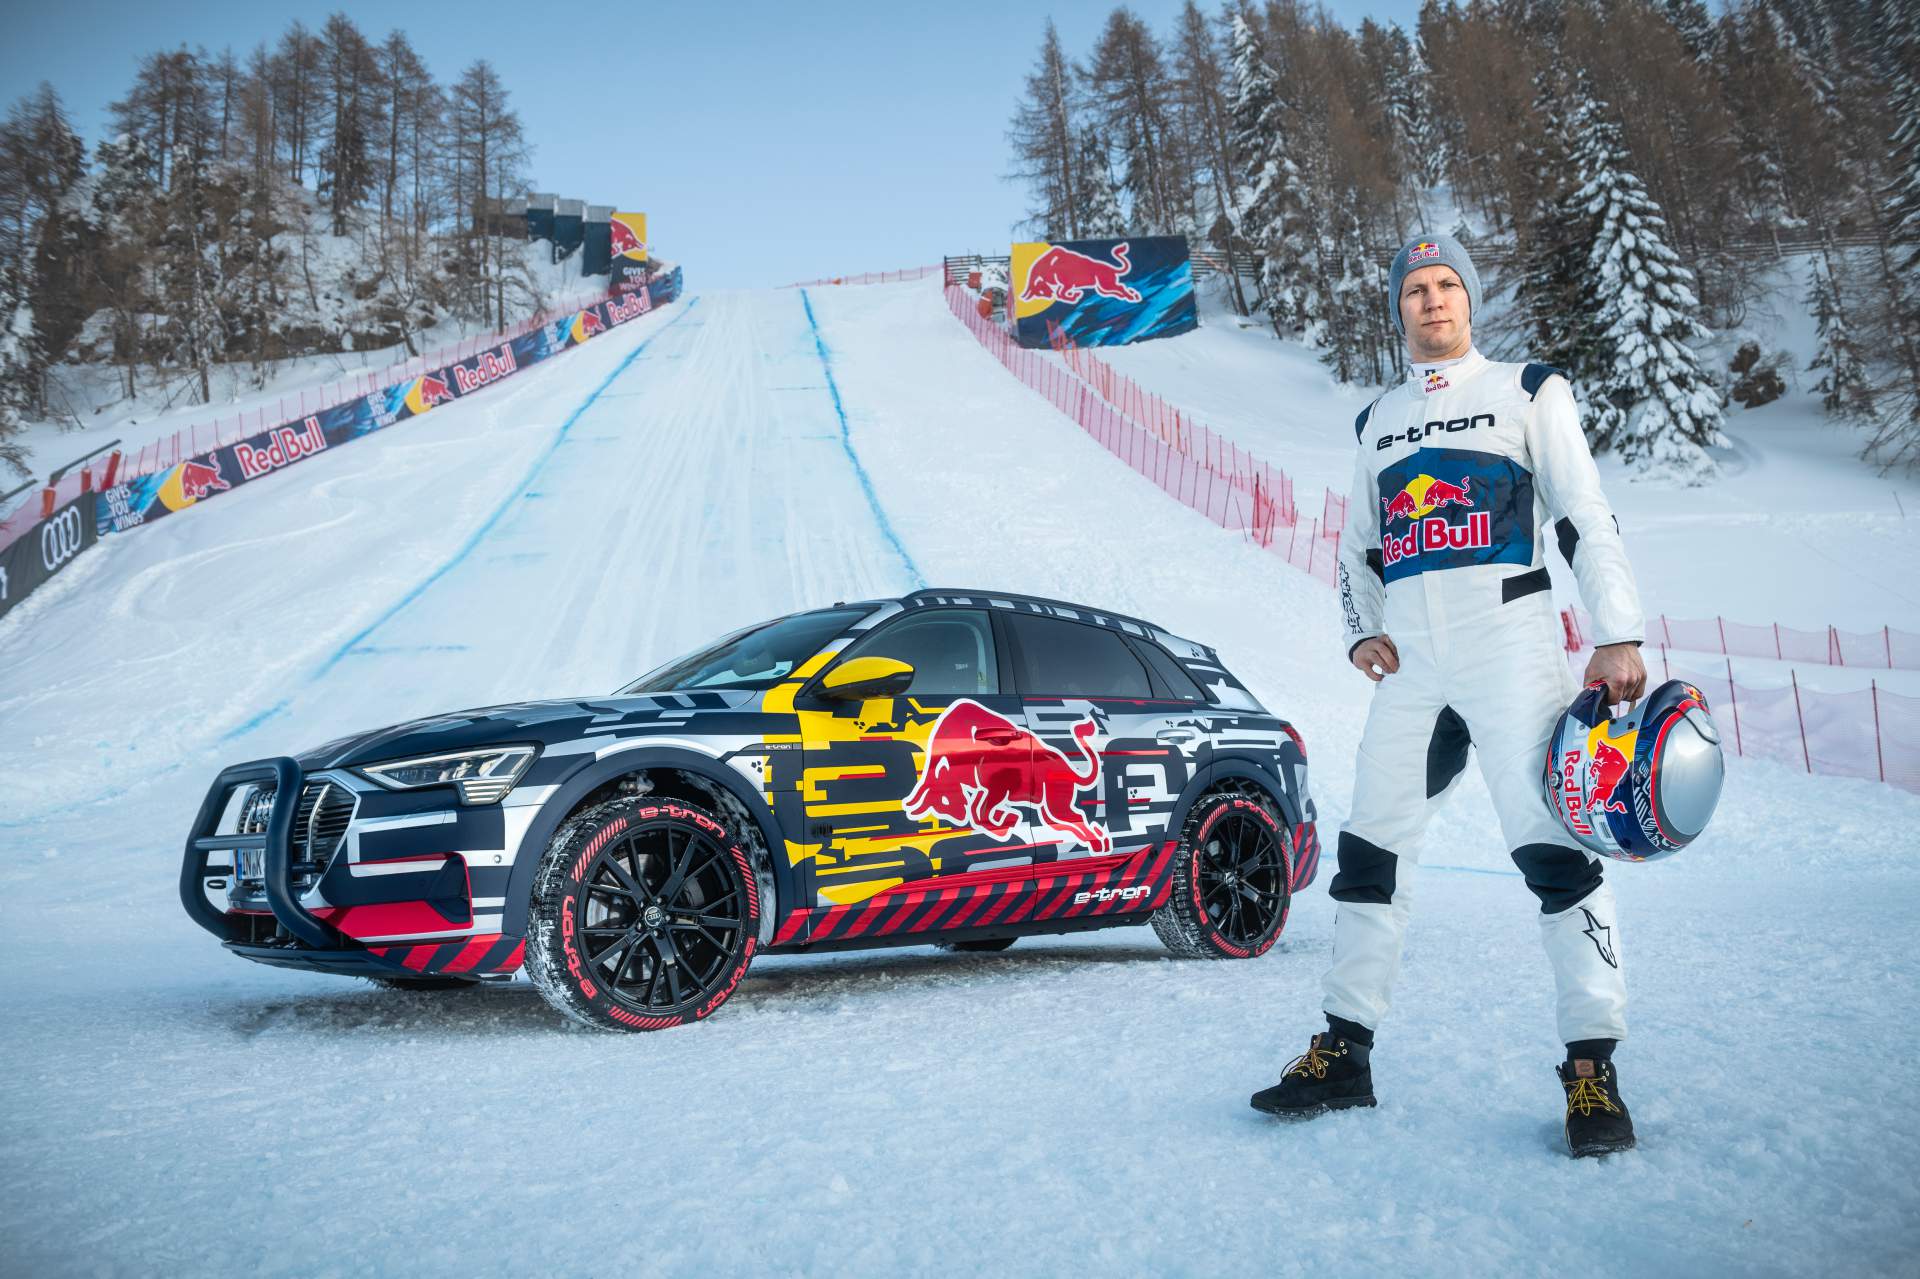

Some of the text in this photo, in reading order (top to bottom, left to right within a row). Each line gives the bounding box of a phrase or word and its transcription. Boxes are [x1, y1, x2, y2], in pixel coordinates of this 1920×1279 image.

[1408, 253, 1423, 264] Red
[606, 285, 651, 325] Red Bull
[453, 343, 517, 394] Red Bull
[1425, 380, 1449, 393] Red Bull
[234, 416, 327, 479] Red Bull
[1376, 413, 1496, 451] e-tron
[105, 484, 131, 503] GIVES
[109, 500, 130, 517] YOU
[113, 511, 144, 531] WINGS
[1383, 511, 1491, 567] Red Bull
[1564, 750, 1593, 835] Red Bull
[639, 804, 727, 838] e-tron
[1233, 799, 1279, 832] e-tron
[1074, 885, 1151, 905] e-tron
[1192, 850, 1208, 925] e-tron
[562, 896, 598, 1000] e-tron
[696, 937, 757, 1018] e-tron
